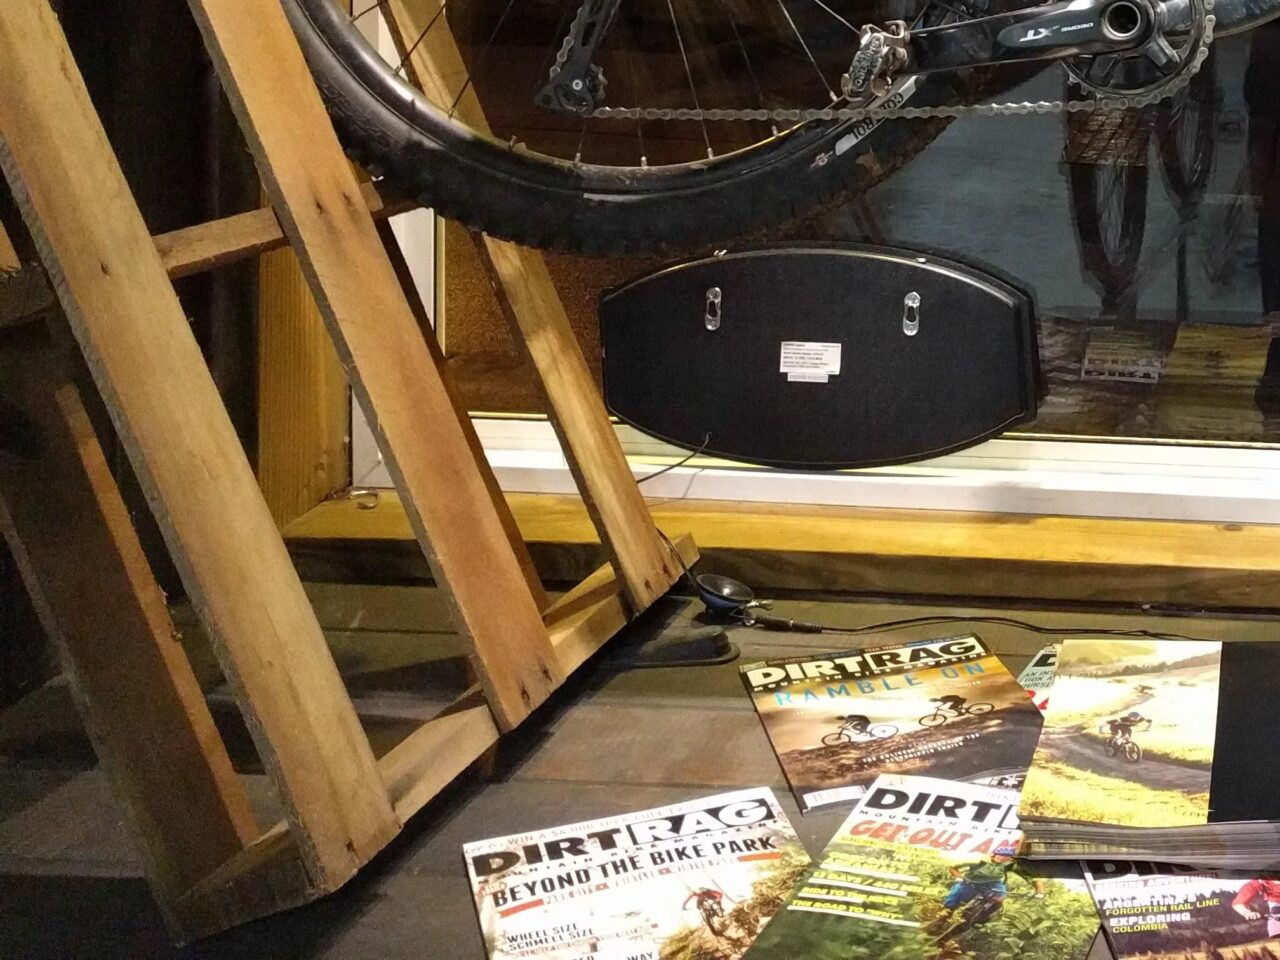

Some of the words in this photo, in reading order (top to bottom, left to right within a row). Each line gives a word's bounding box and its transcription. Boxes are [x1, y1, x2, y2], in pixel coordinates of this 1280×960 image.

[747, 656, 863, 688] DIRT
[870, 641, 977, 668] RAG
[753, 675, 842, 692] MOUNTAIN
[854, 668, 892, 677] BIKE
[903, 652, 987, 670] MAGAZINE
[774, 674, 924, 706] RAMBLE
[940, 662, 986, 680] ON
[859, 809, 957, 827] MOUNTAIN
[864, 787, 1002, 823] DIRT
[472, 828, 622, 878] DIRT
[630, 801, 768, 845] RAG
[849, 819, 910, 842] GET
[908, 827, 973, 852] OUT
[492, 868, 592, 908] BEYOND
[597, 855, 644, 879] THE
[649, 844, 707, 866] BIKE
[712, 836, 776, 856] PARK
[1105, 905, 1168, 916] FORGOTTEN
[1170, 901, 1194, 912] RAIL
[1196, 898, 1220, 909] LINE
[1109, 912, 1191, 927] EXPLORING
[506, 927, 549, 944] WHEEL
[553, 922, 578, 934] SIZE
[568, 928, 595, 940] SIZE
[1112, 923, 1169, 934] COLOMBIA
